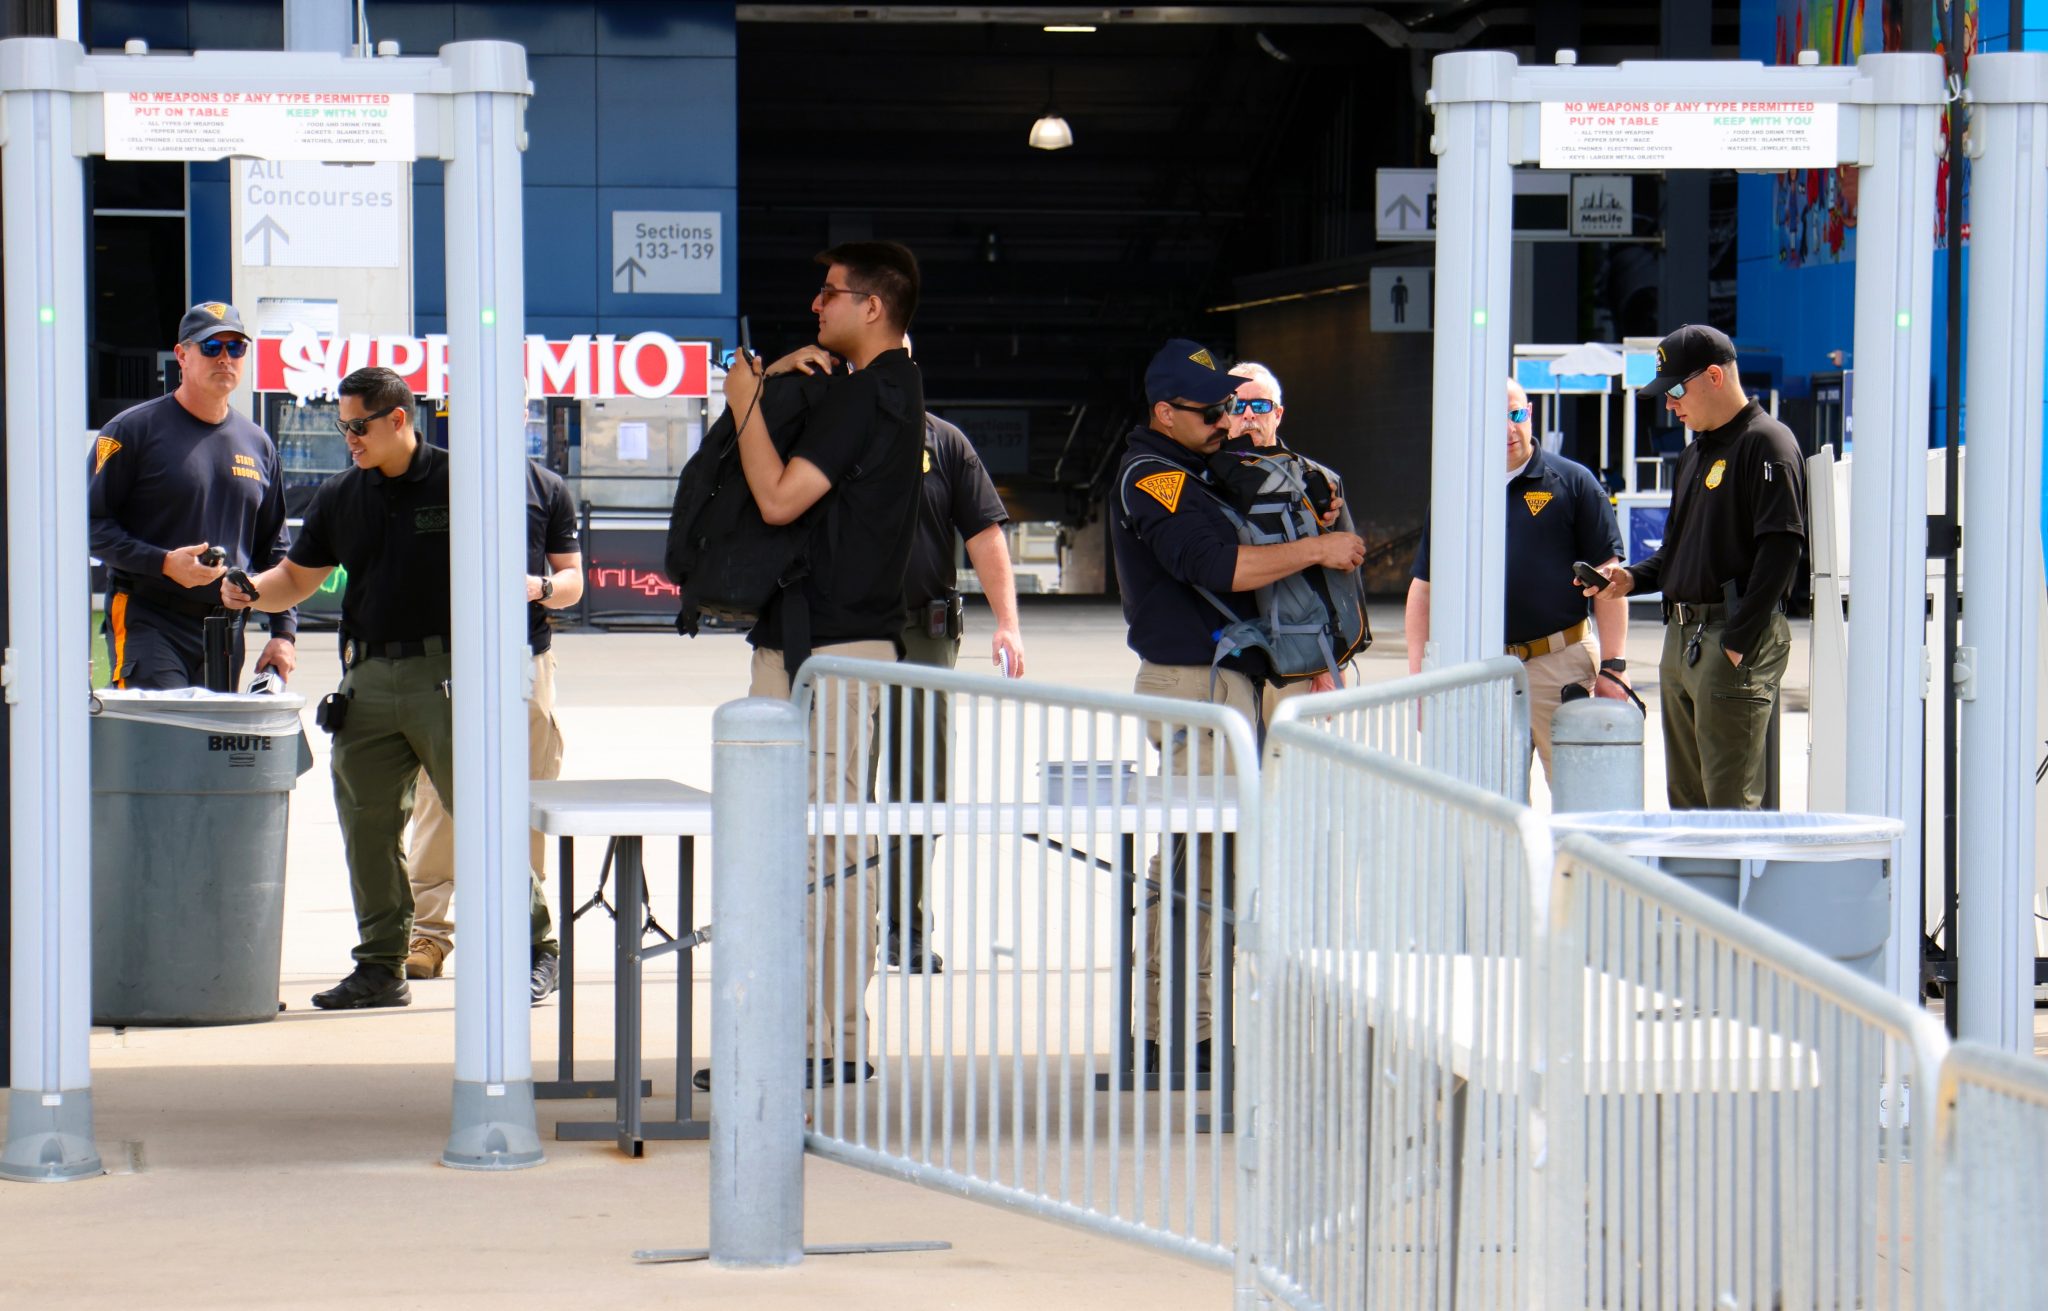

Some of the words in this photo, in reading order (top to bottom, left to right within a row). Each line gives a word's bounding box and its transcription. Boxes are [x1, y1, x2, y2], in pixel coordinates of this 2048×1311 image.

[130, 92, 148, 102] NO
[153, 92, 218, 102] WEAPONS
[223, 92, 240, 102] OF
[244, 93, 272, 102] ANY
[276, 94, 310, 103] TYPE
[315, 94, 390, 104] PERMITTED
[135, 108, 160, 116] PUT
[164, 108, 183, 116] ON
[188, 108, 229, 116] TABLE
[1564, 102, 1583, 111] NO
[1587, 102, 1649, 111] WEAPONS
[1654, 102, 1670, 111] OF
[1674, 102, 1701, 111] ANY
[1706, 102, 1738, 111] TYPE
[1742, 102, 1814, 111] PERMITTED
[286, 109, 319, 117] KEEP
[324, 109, 356, 117] WITH
[361, 109, 388, 117] YOU
[1570, 117, 1594, 126] PUT
[1598, 117, 1615, 126] ON
[1620, 117, 1658, 126] TABLE
[1714, 117, 1745, 125] KEEP
[1750, 117, 1781, 125] WITH
[1785, 117, 1812, 125] YOU
[248, 160, 284, 179] All
[248, 184, 393, 208] Concourses
[1581, 212, 1623, 223] MetLife
[636, 223, 712, 240] Sections
[636, 242, 714, 260] 133-139
[234, 454, 255, 468] STATE
[232, 466, 260, 481] TROOPER
[1147, 477, 1177, 488] STATE
[208, 735, 272, 752] BRUTE
